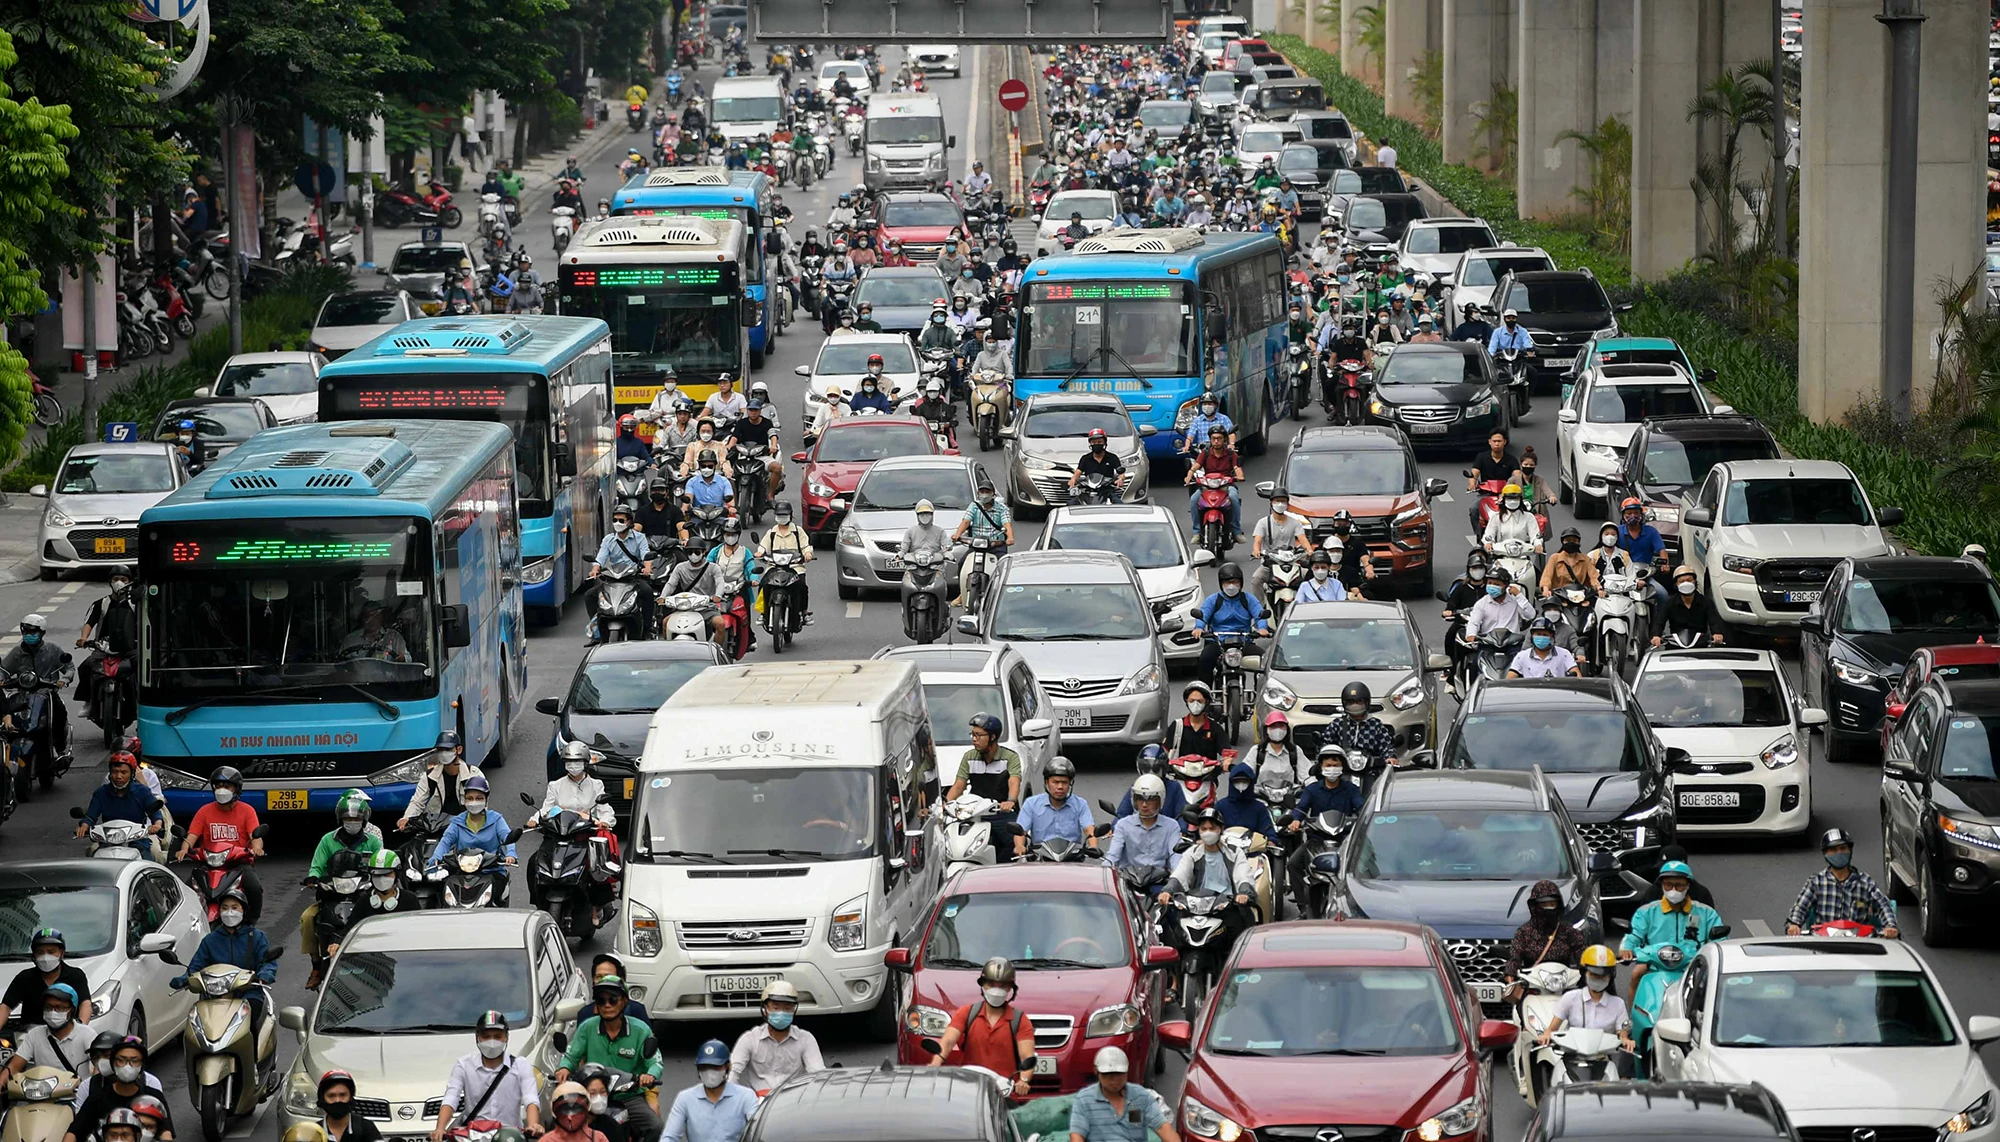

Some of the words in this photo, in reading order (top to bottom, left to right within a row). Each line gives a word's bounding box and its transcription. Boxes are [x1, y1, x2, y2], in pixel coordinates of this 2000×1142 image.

[1068, 382, 1088, 392] BUS
[1065, 709, 1081, 718] 30H
[1059, 718, 1087, 726] 718.73
[220, 736, 237, 748] XN
[240, 735, 263, 748] BUS
[266, 734, 310, 747] NHANH
[314, 731, 330, 746] HÀ
[334, 731, 358, 748] NỘI
[684, 742, 835, 759] LIMOUSINE
[279, 791, 297, 800] 29B
[1681, 794, 1738, 806] 30E-858.34
[272, 801, 304, 810] 209.67
[733, 930, 754, 940] Ford
[620, 1047, 636, 1056] Grab
